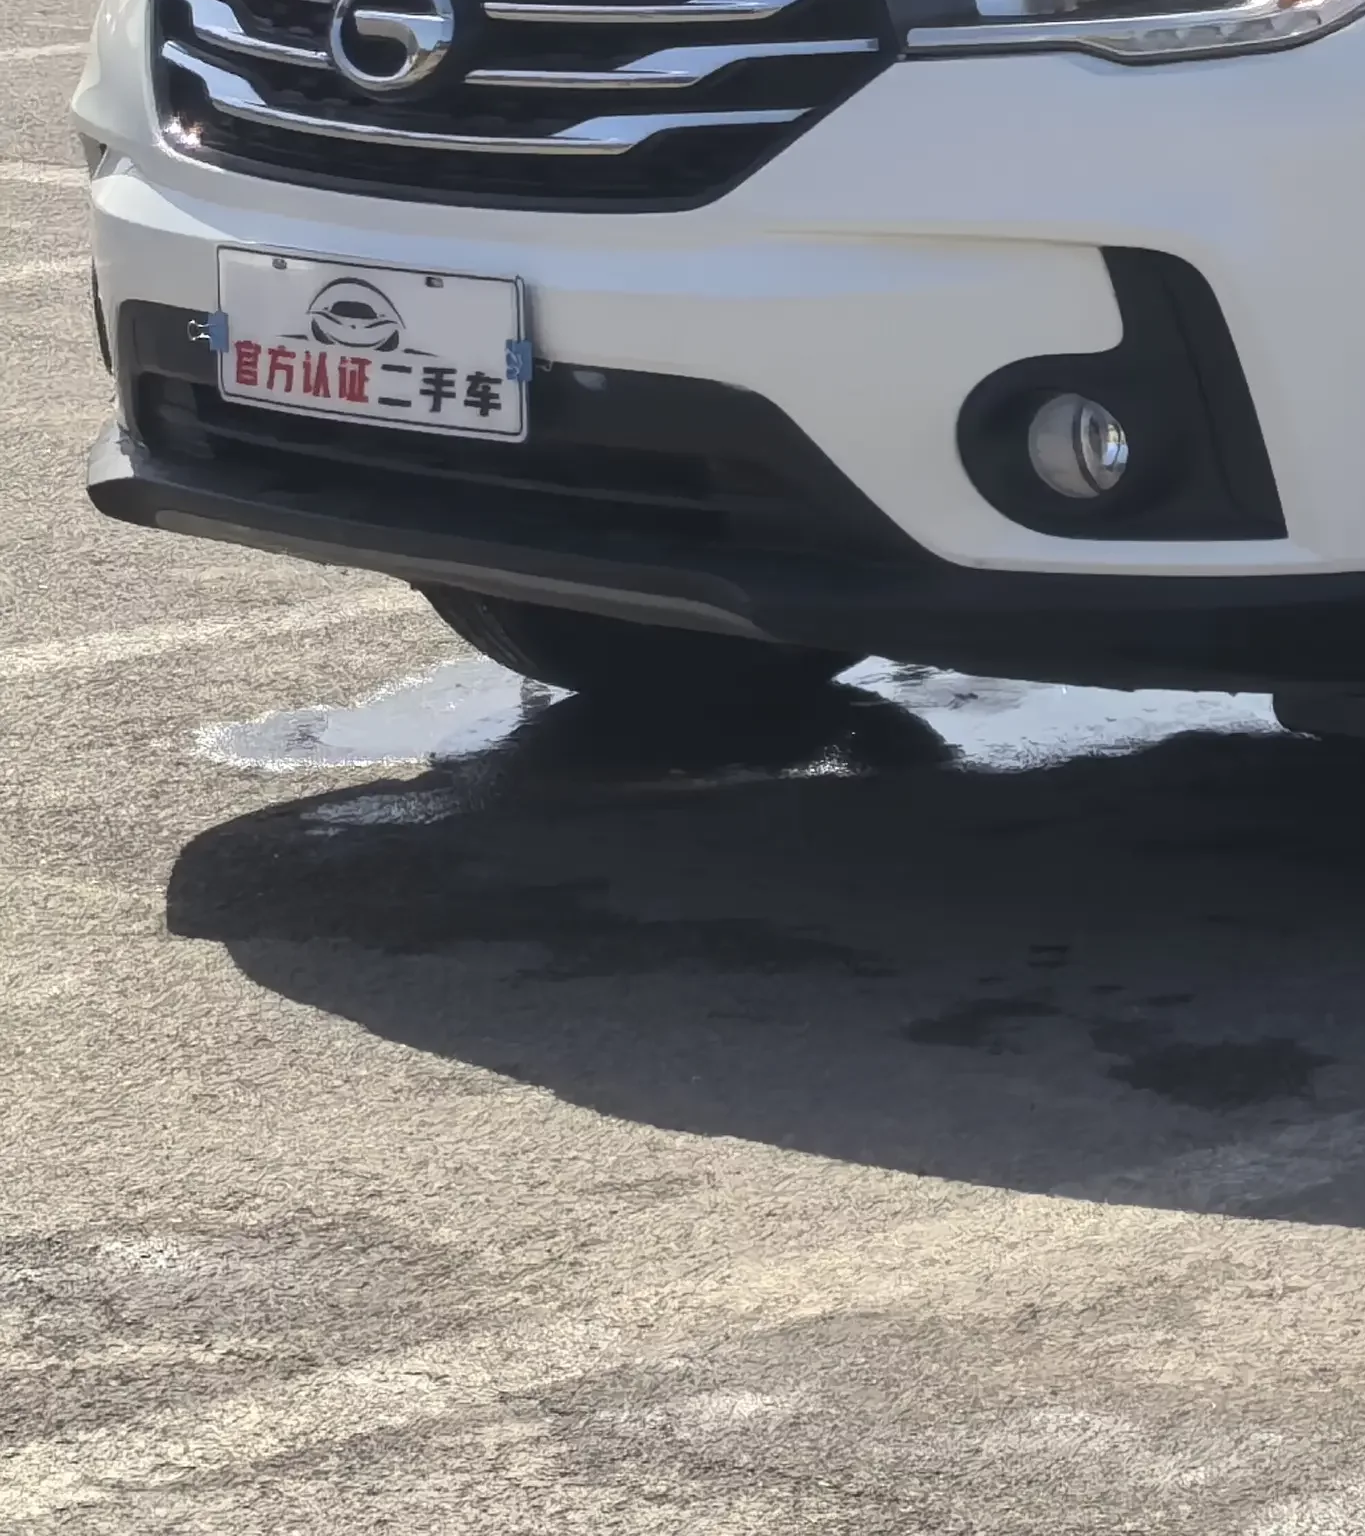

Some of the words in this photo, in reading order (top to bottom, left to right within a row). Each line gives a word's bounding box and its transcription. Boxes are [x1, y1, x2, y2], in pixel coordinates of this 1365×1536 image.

[234, 340, 502, 417] 官方认证二手车
